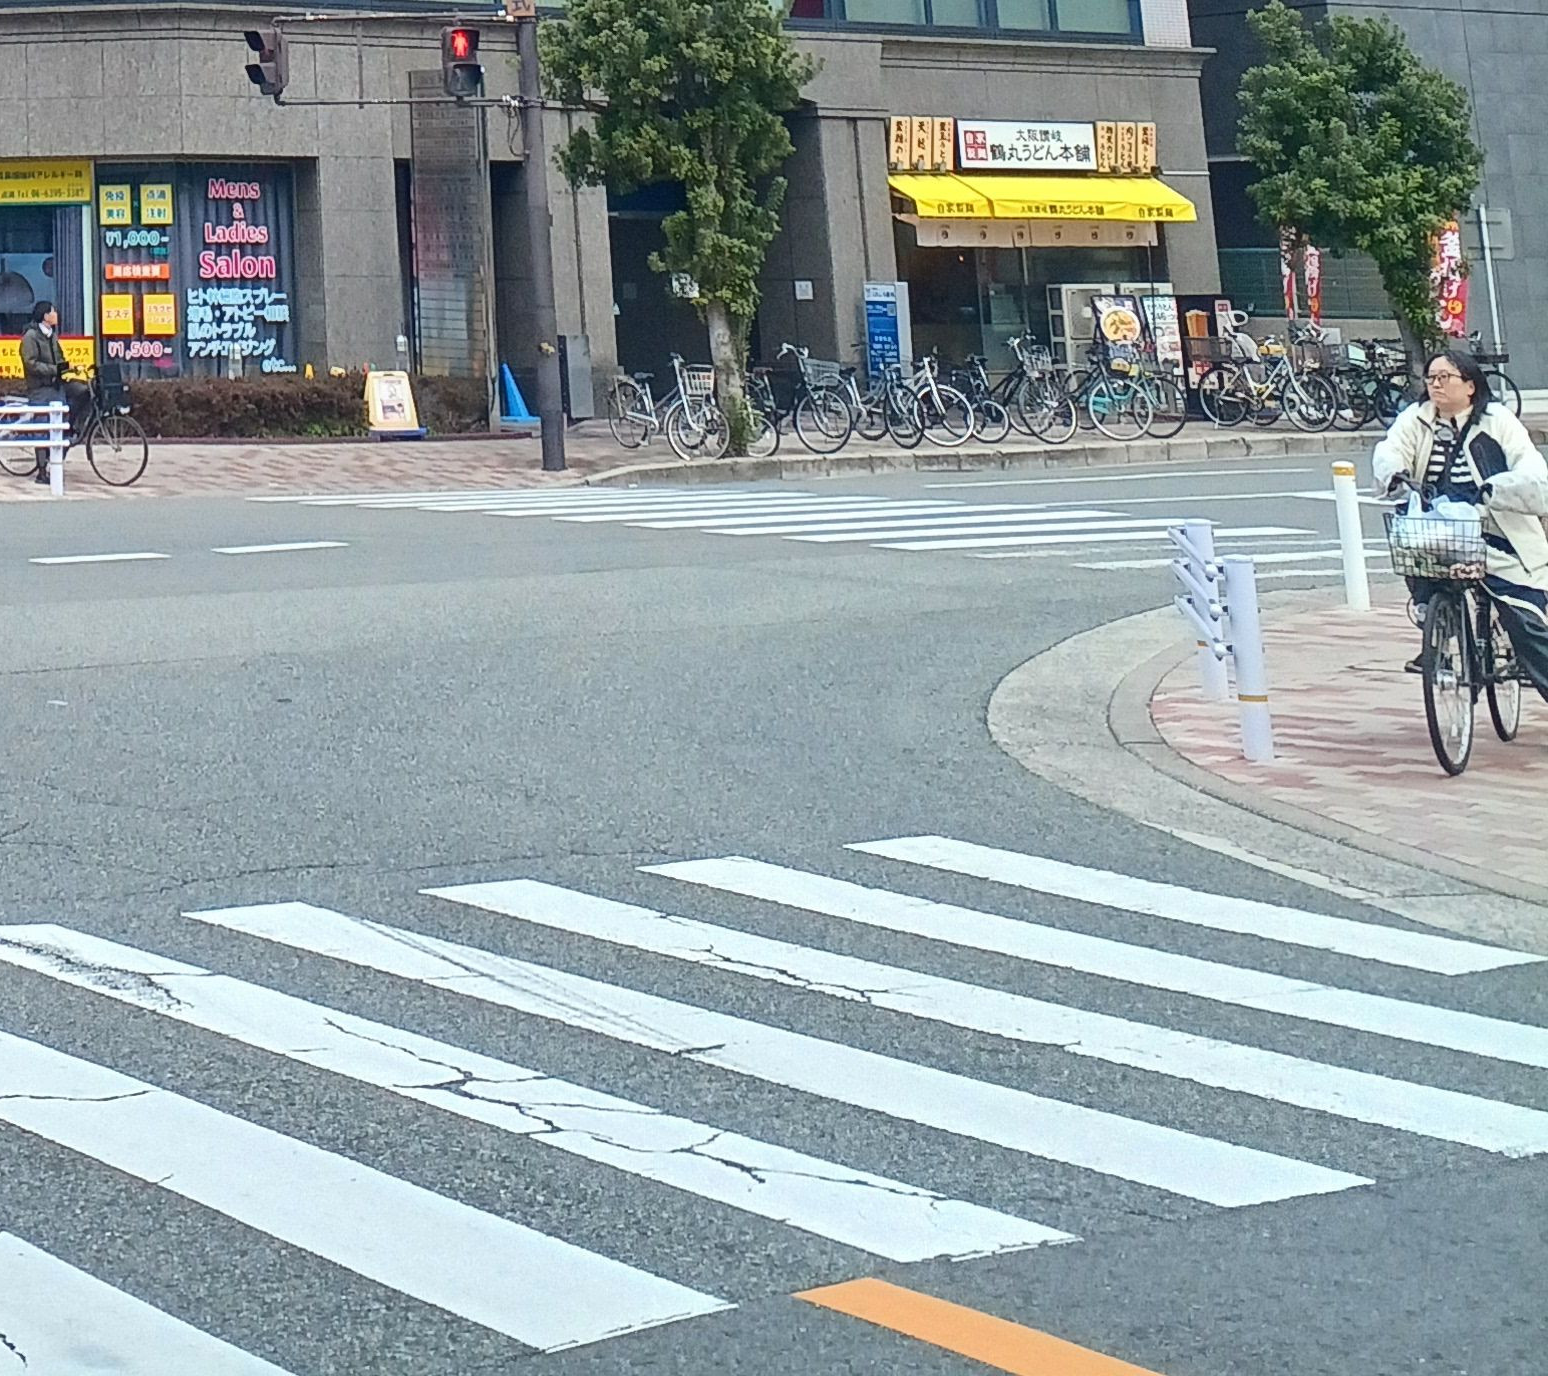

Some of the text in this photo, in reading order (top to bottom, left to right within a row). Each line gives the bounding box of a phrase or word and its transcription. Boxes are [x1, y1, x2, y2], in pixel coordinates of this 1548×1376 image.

[990, 144, 1091, 162] 鶴丸うどん本舗
[208, 178, 260, 199] Mens
[232, 202, 244, 219] &
[204, 221, 268, 244] Ladies
[199, 249, 276, 279] Salon
[106, 310, 131, 319] エステ
